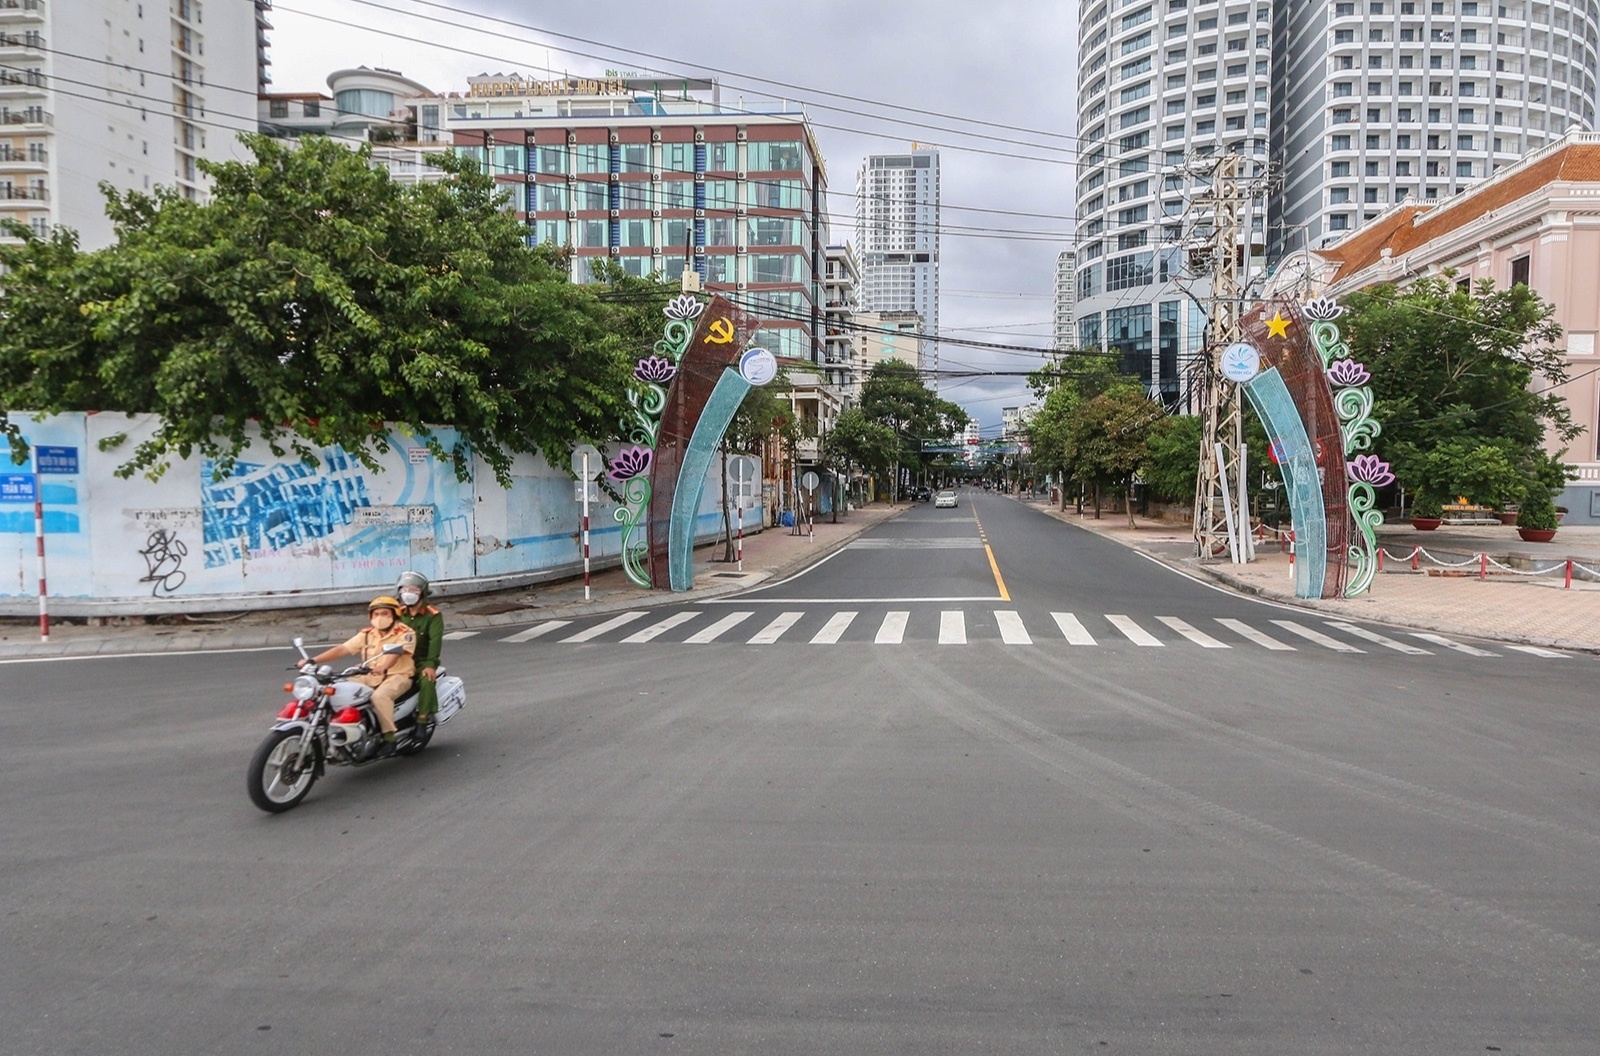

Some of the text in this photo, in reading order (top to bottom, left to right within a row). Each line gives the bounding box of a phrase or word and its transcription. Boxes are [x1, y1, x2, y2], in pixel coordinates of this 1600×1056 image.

[605, 69, 618, 77] ibis
[470, 78, 627, 97] HAPPY LIGHT HOTEL
[1, 480, 33, 494] TRẦN PHÚ
